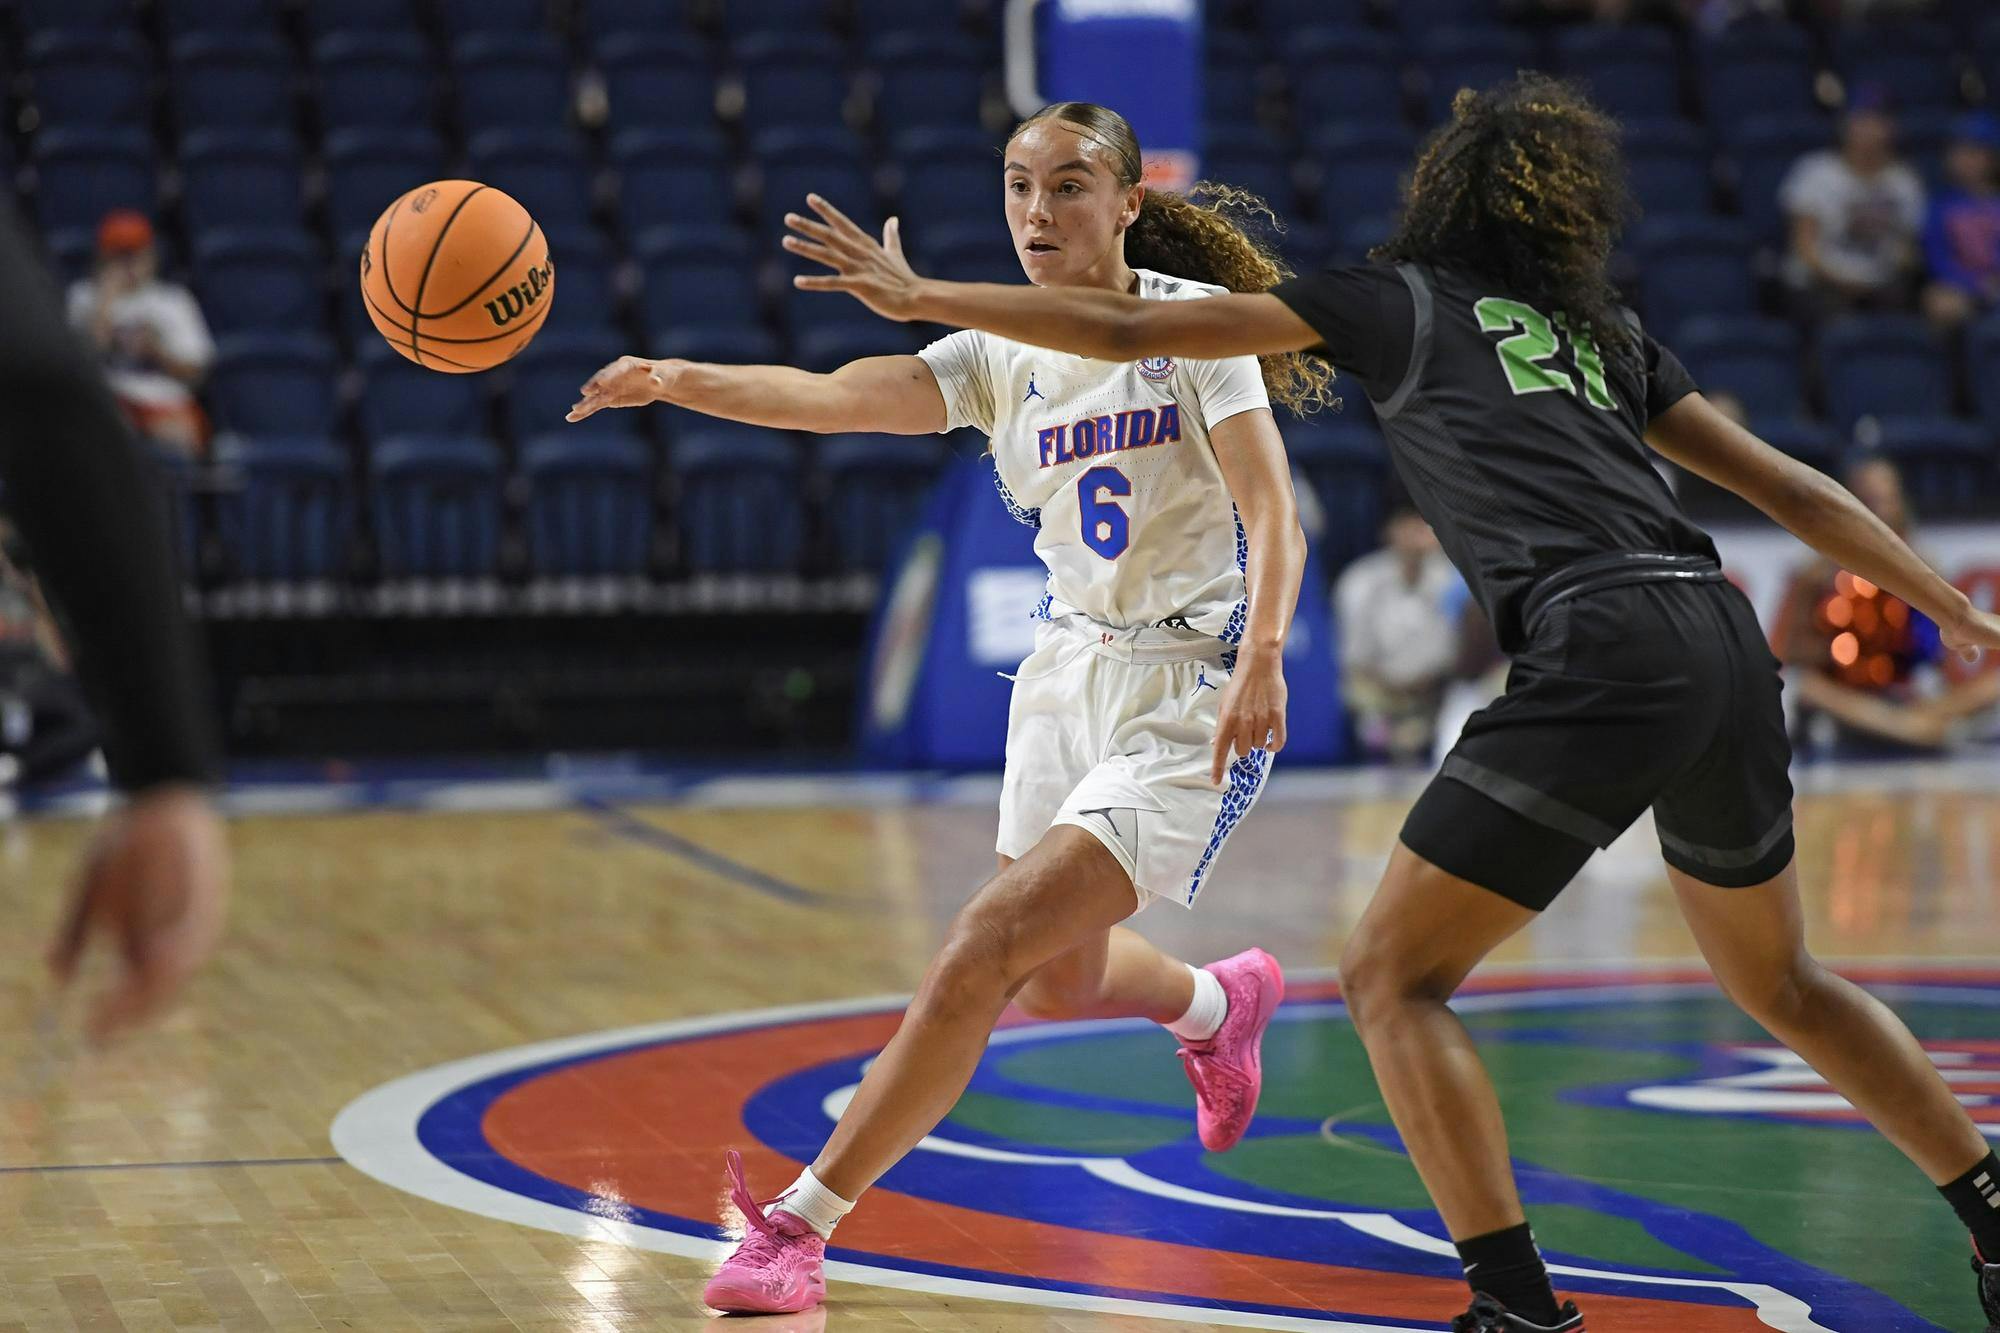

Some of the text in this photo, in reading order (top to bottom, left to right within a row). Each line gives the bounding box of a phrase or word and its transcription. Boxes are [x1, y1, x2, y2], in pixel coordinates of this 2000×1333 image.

[1473, 297, 1618, 411] 21
[1038, 403, 1182, 469] FLORIDA
[1077, 466, 1132, 561] 6
